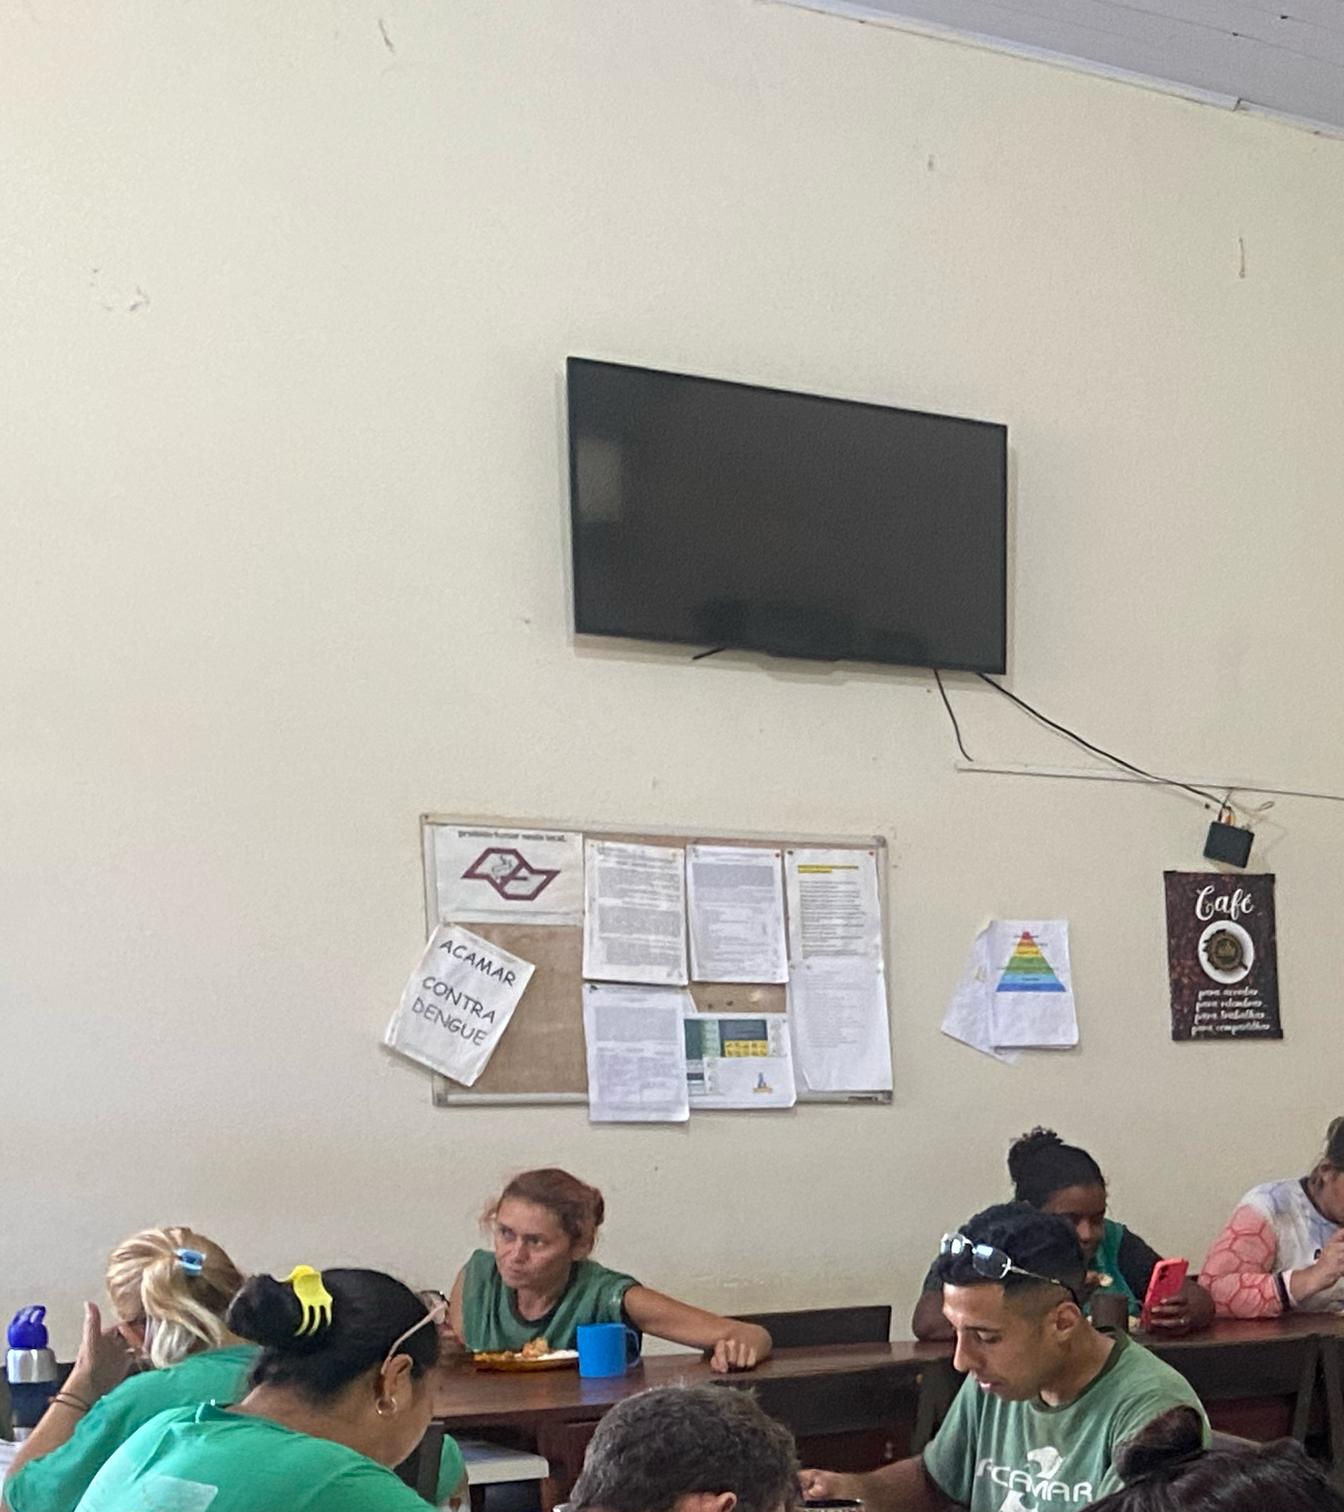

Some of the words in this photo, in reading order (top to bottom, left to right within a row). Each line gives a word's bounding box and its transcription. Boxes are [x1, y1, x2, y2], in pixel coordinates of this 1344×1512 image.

[1195, 885, 1255, 921] Café
[440, 940, 517, 987] ACAMAR
[411, 996, 488, 1046] DENGUE
[422, 976, 496, 1024] CONTRA
